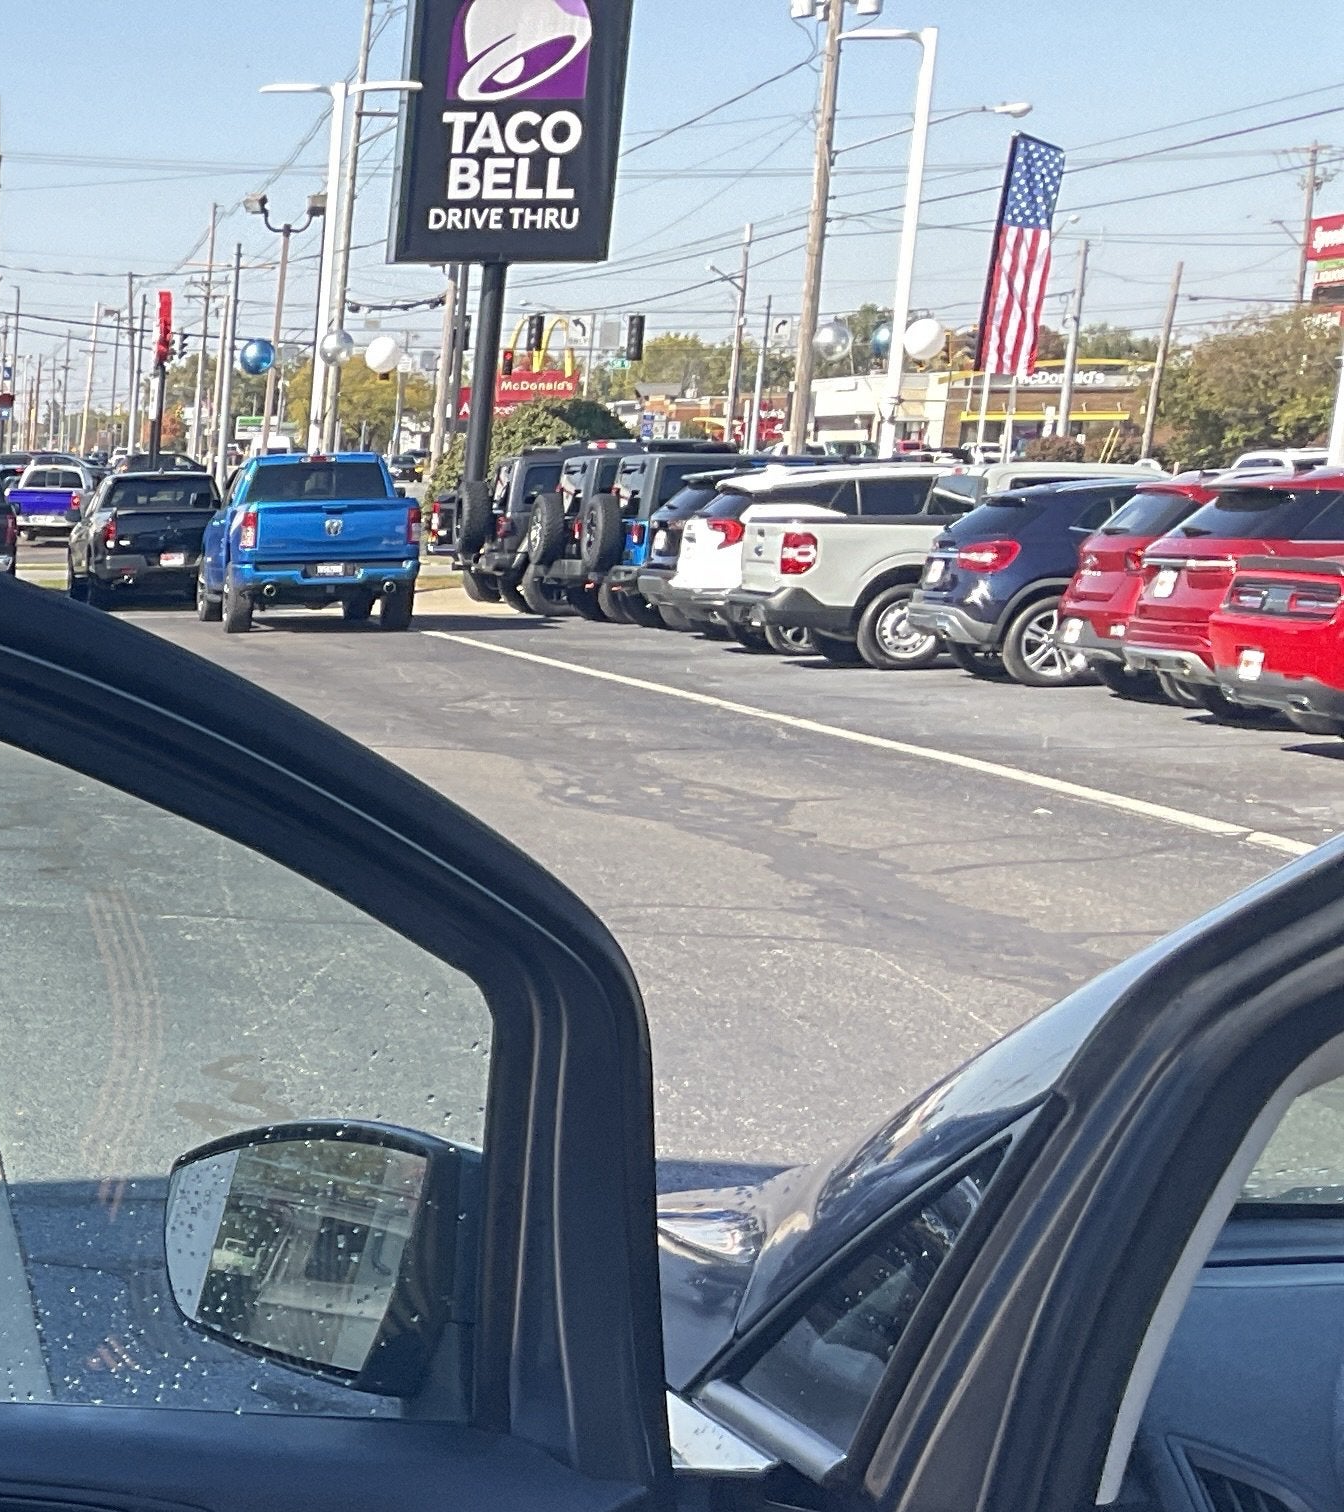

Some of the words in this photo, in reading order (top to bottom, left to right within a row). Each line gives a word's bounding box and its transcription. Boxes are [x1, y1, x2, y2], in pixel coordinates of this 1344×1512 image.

[442, 110, 582, 154] TACO
[447, 157, 574, 200] BELL
[428, 207, 503, 229] DRIVE
[510, 207, 579, 230] THRU
[500, 380, 573, 391] McDonald's
